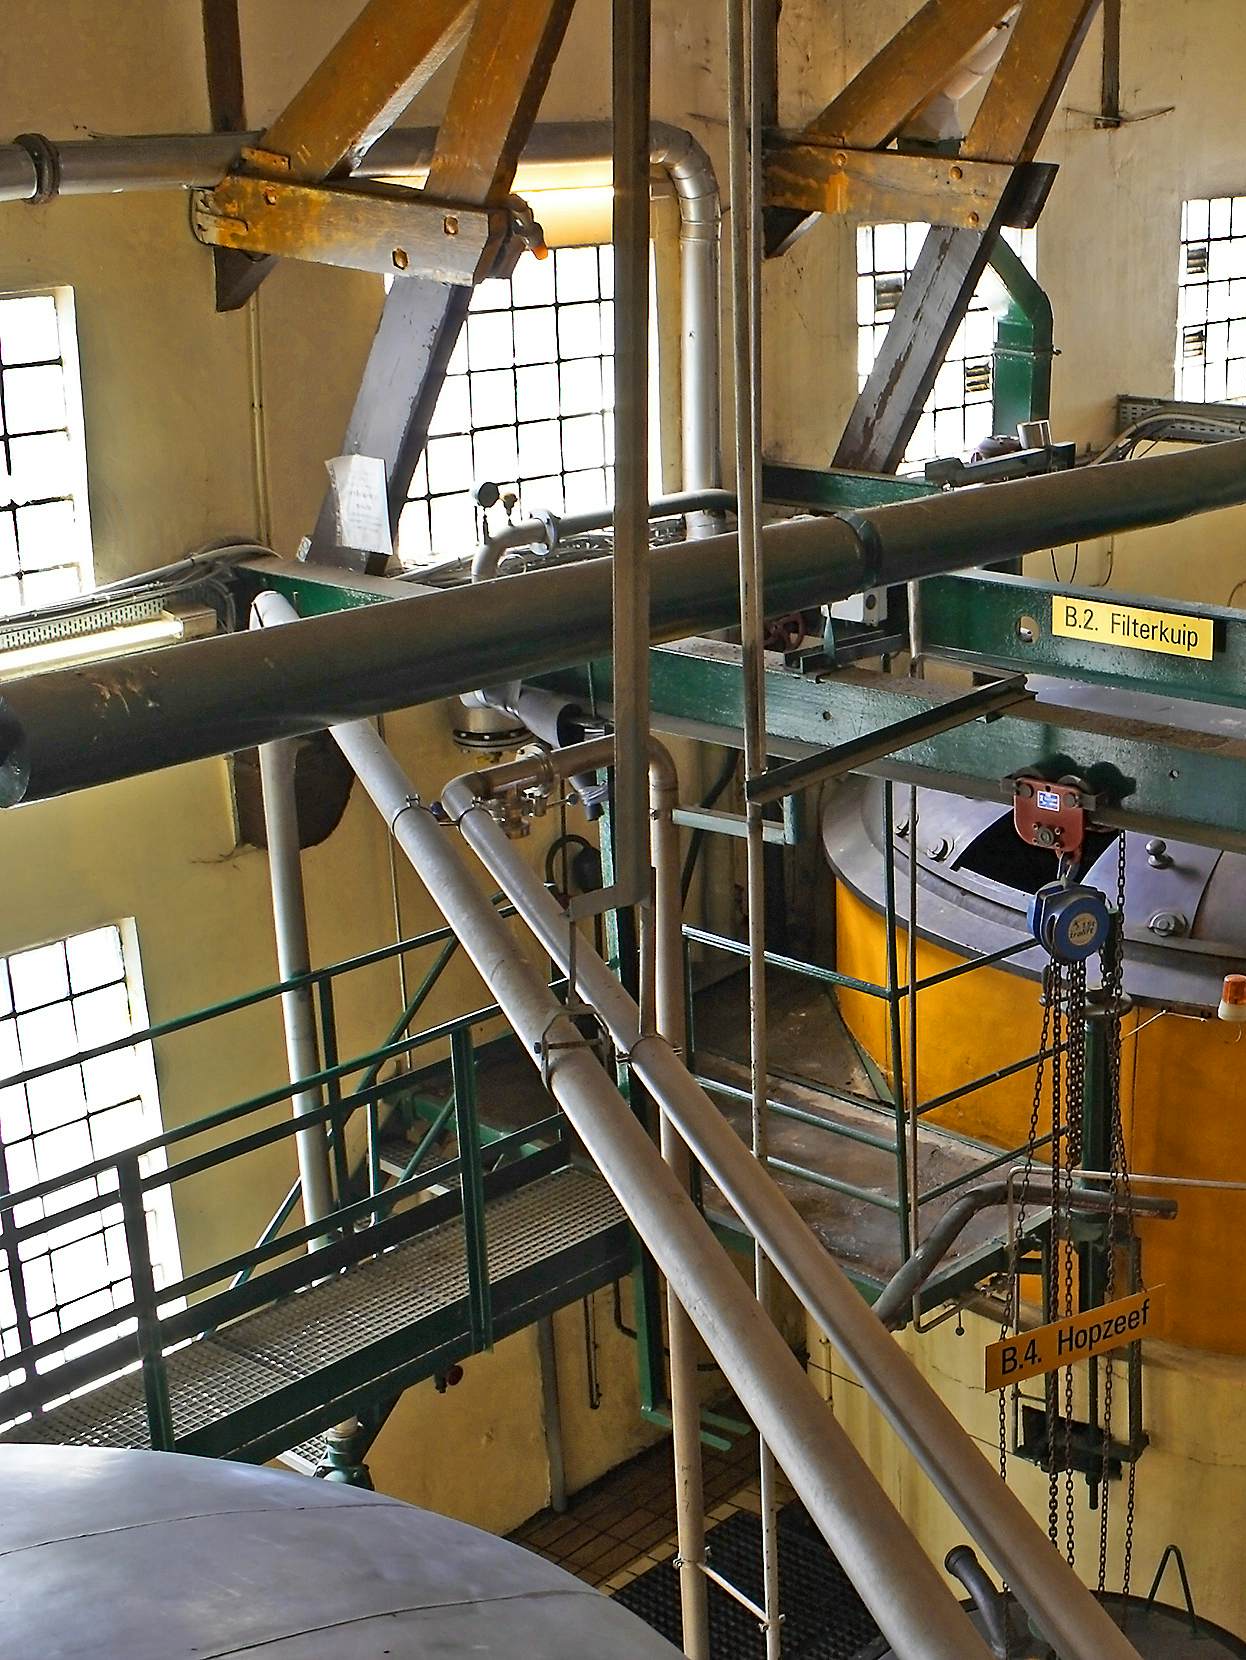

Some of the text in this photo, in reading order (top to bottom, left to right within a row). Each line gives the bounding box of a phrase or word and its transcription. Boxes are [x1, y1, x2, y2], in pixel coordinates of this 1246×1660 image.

[1065, 605, 1199, 651] B.2. Filterkuip
[1001, 1298, 1150, 1375] B.4. Hopzeef
